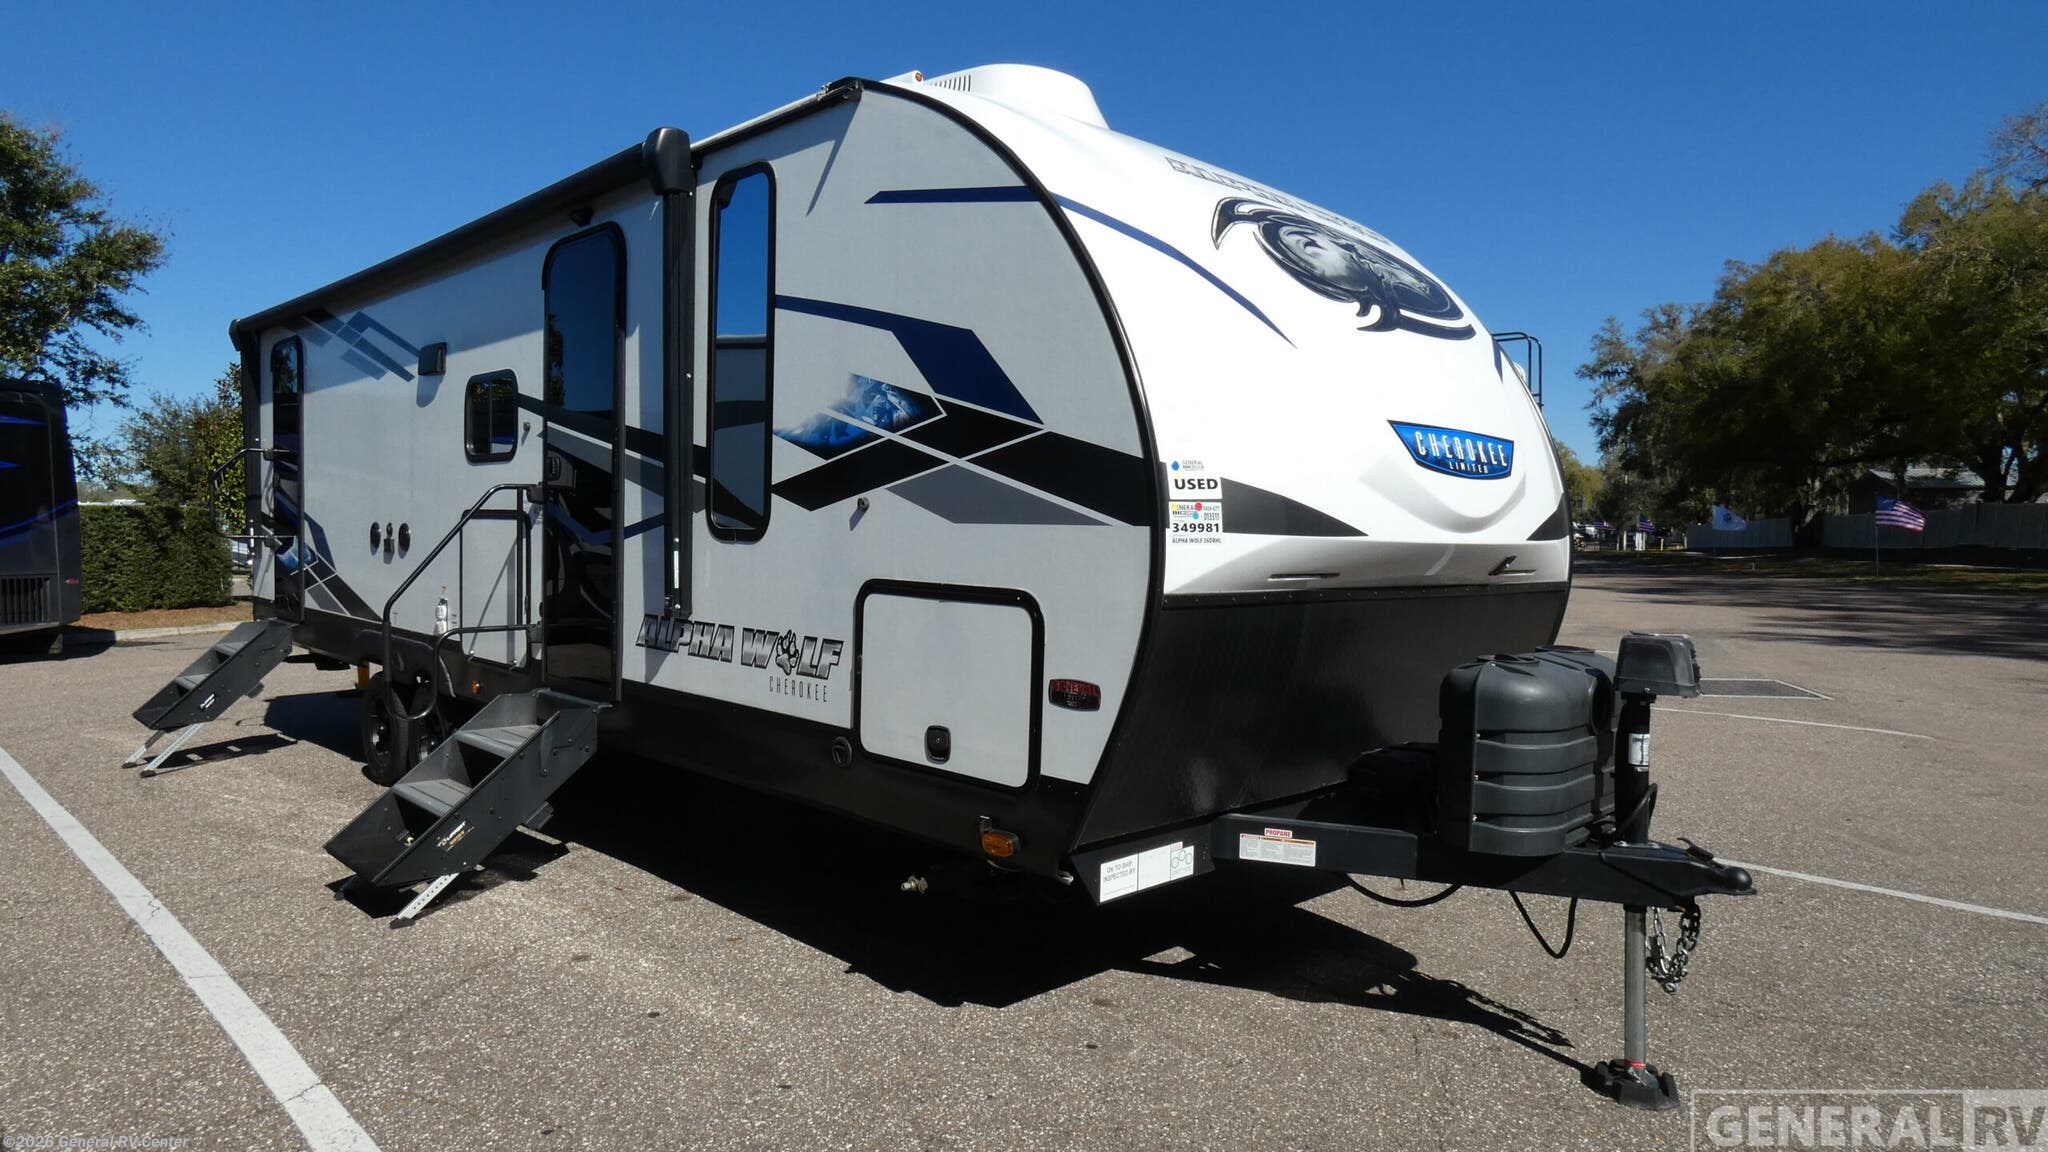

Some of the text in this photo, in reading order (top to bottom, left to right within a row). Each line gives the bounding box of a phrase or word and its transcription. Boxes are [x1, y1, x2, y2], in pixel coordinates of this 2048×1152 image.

[1414, 431, 1508, 467] CHEROKEE
[1448, 461, 1489, 474] LIMITED
[1174, 478, 1219, 490] USED
[1172, 522, 1220, 532] 349981
[636, 614, 735, 663] ALPHA
[769, 676, 828, 702] CHEROKEE
[1265, 829, 1291, 837] PROPANE
